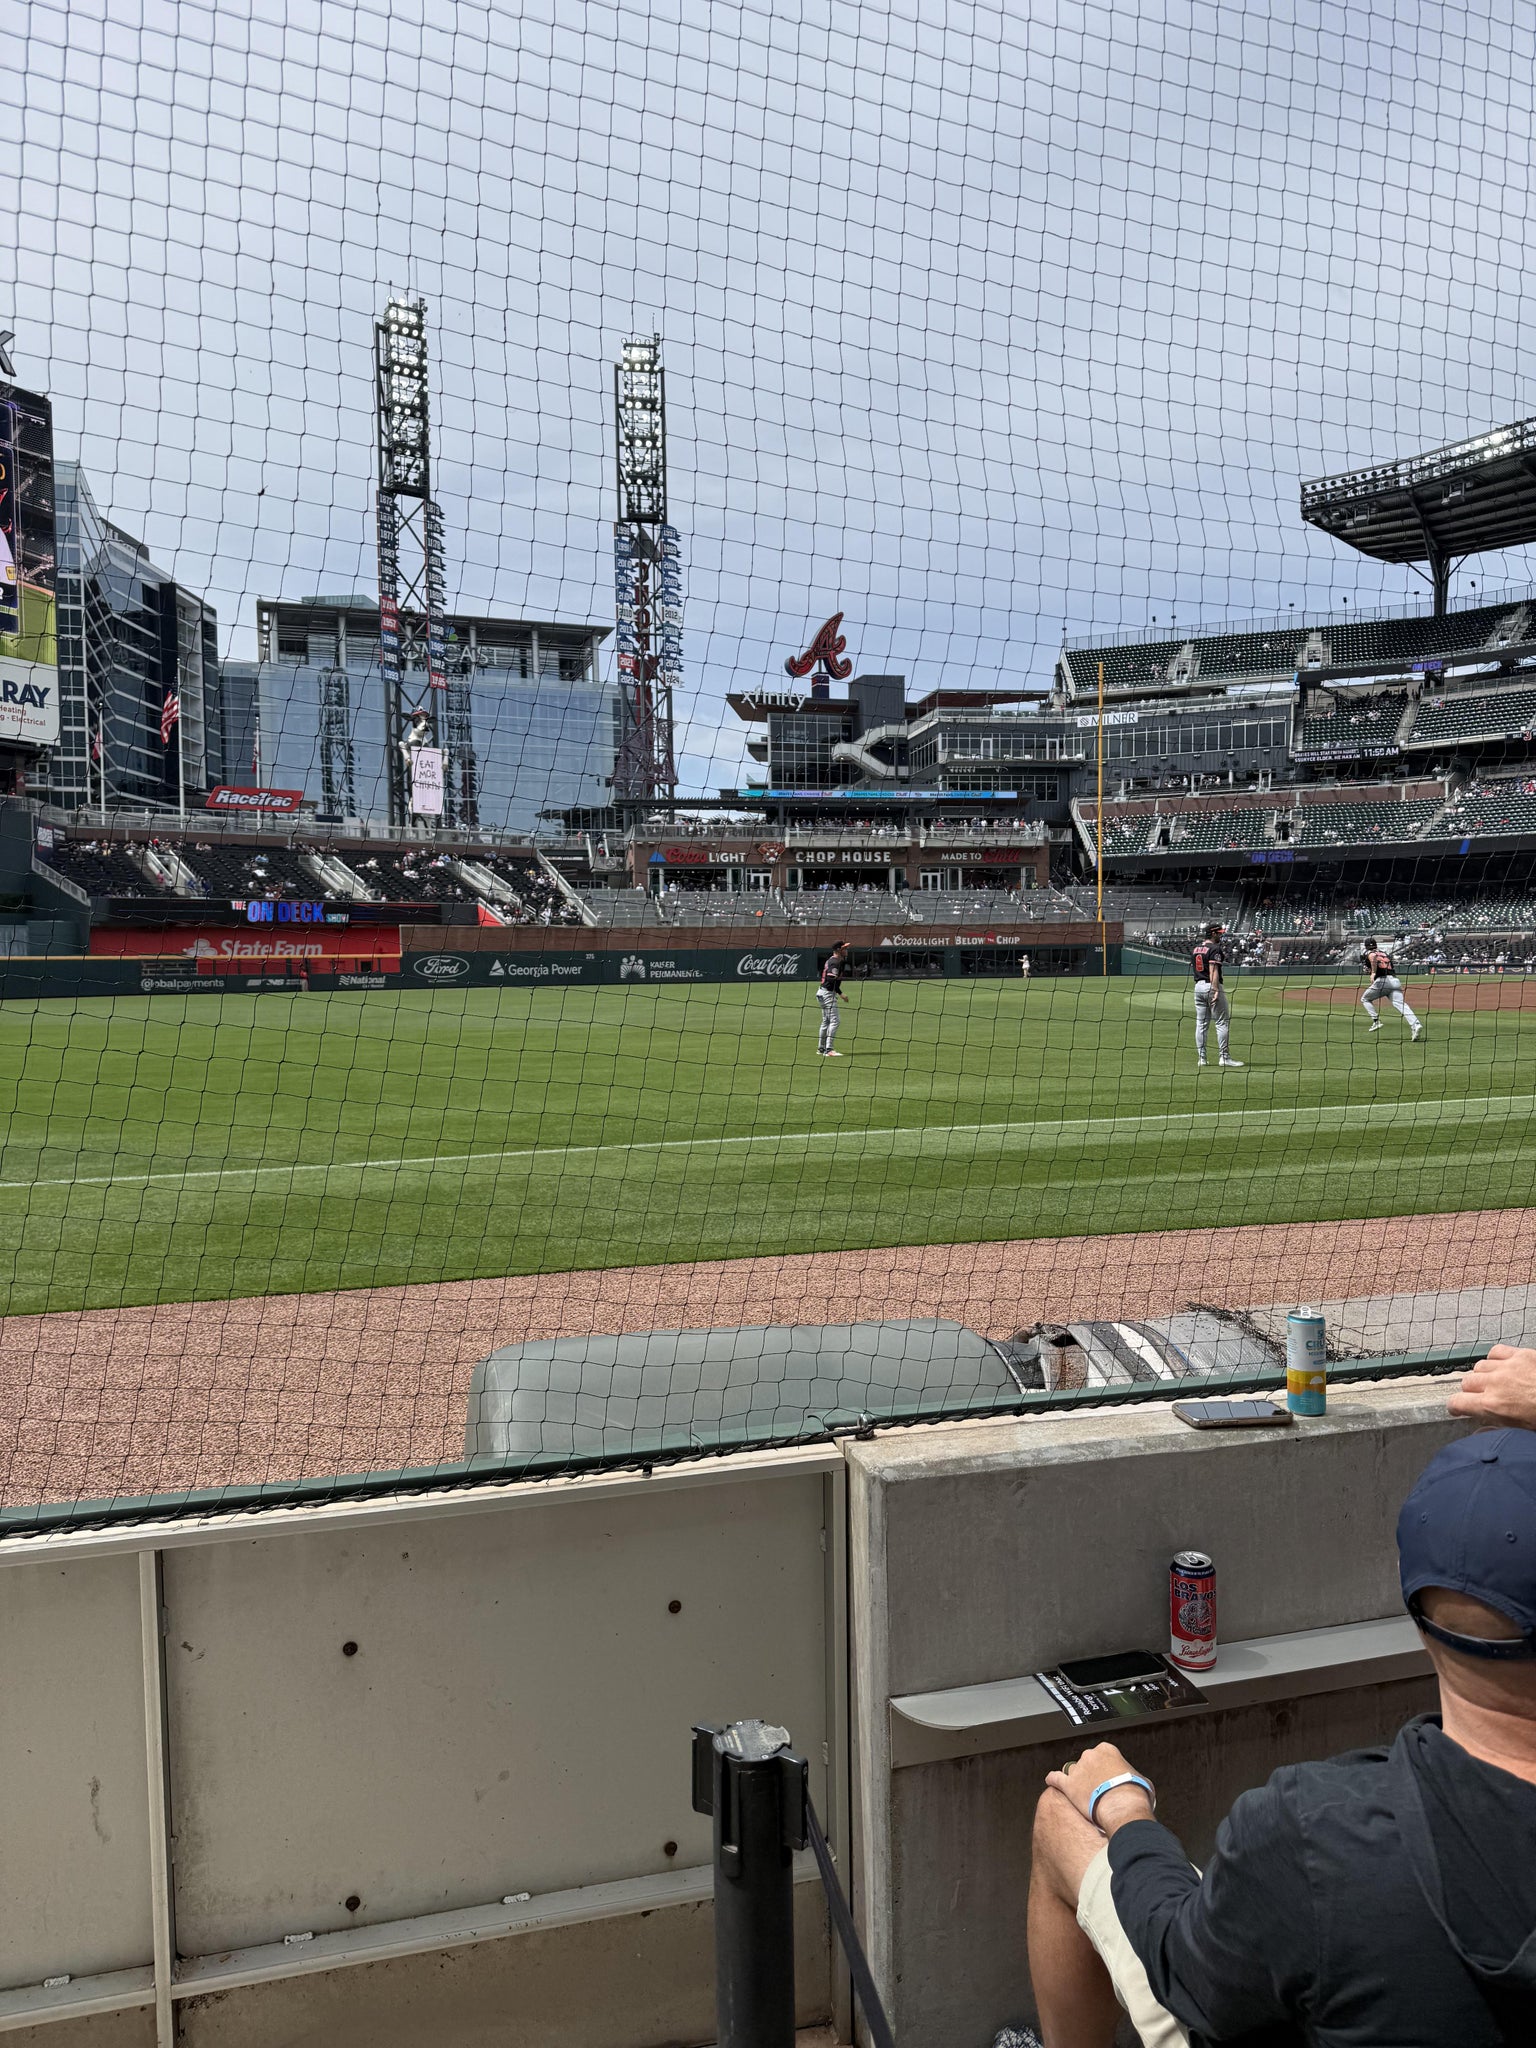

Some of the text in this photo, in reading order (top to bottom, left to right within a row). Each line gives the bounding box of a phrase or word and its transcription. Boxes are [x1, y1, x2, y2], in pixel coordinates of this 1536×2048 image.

[0, 679, 51, 709] RAY
[1386, 746, 1399, 756] AM
[420, 760, 435, 770] EAT
[418, 770, 436, 780] MOR
[215, 790, 293, 808] RaceTrac
[708, 852, 746, 863] LIGHT
[796, 851, 892, 863] CHOP HOUSE
[941, 852, 968, 860] MADE
[970, 852, 982, 860] TO
[247, 900, 274, 922] ON
[277, 902, 325, 922] DECK
[892, 934, 922, 946] Coors
[923, 938, 950, 946] LIGHT
[956, 936, 984, 945] BELOW
[996, 936, 1020, 944] CHOP
[424, 958, 460, 974] Ford
[508, 964, 582, 978] Georgia Power
[737, 954, 801, 976] Coca-Cola
[350, 976, 386, 984] National
[1174, 1578, 1197, 1592] LOS
